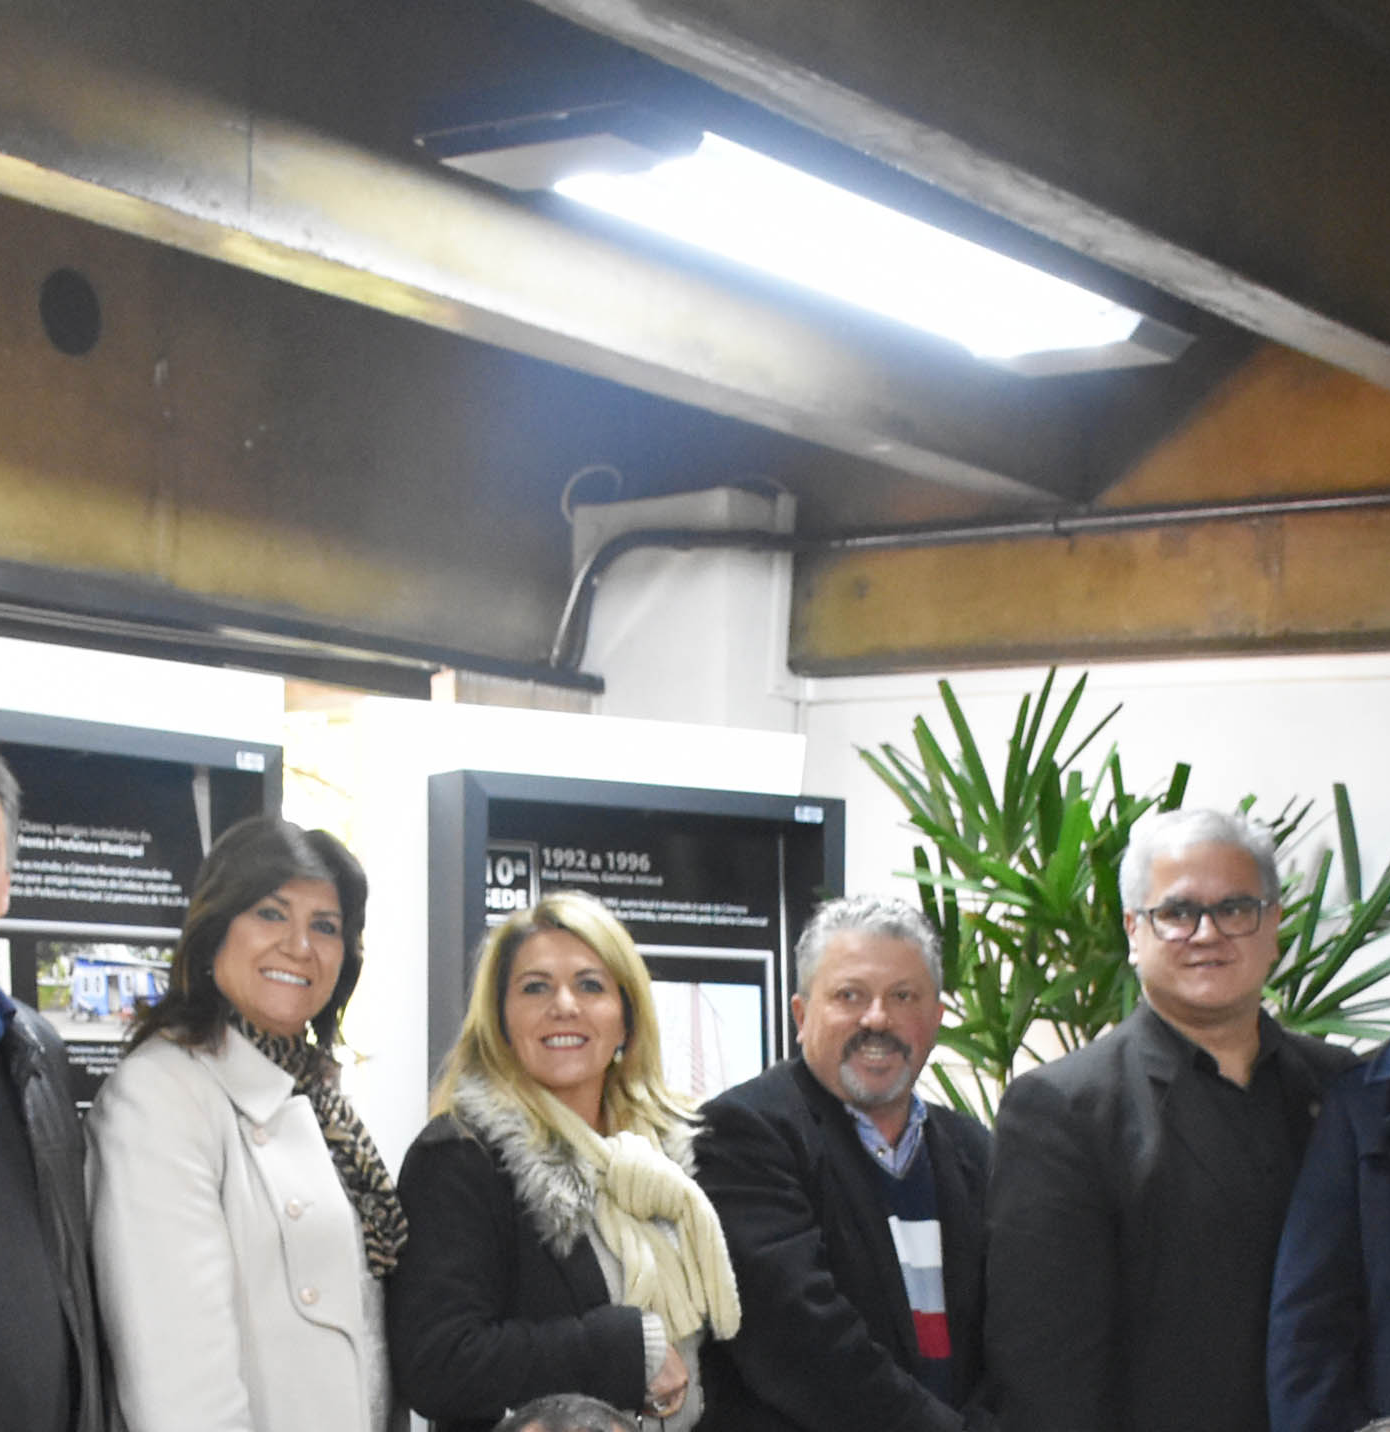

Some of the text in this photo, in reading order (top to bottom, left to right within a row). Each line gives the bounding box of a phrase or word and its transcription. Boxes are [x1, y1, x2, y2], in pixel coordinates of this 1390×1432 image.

[54, 836, 100, 854] Prefeitura
[100, 840, 144, 859] Municipal
[541, 847, 651, 872] 1992 a 1996
